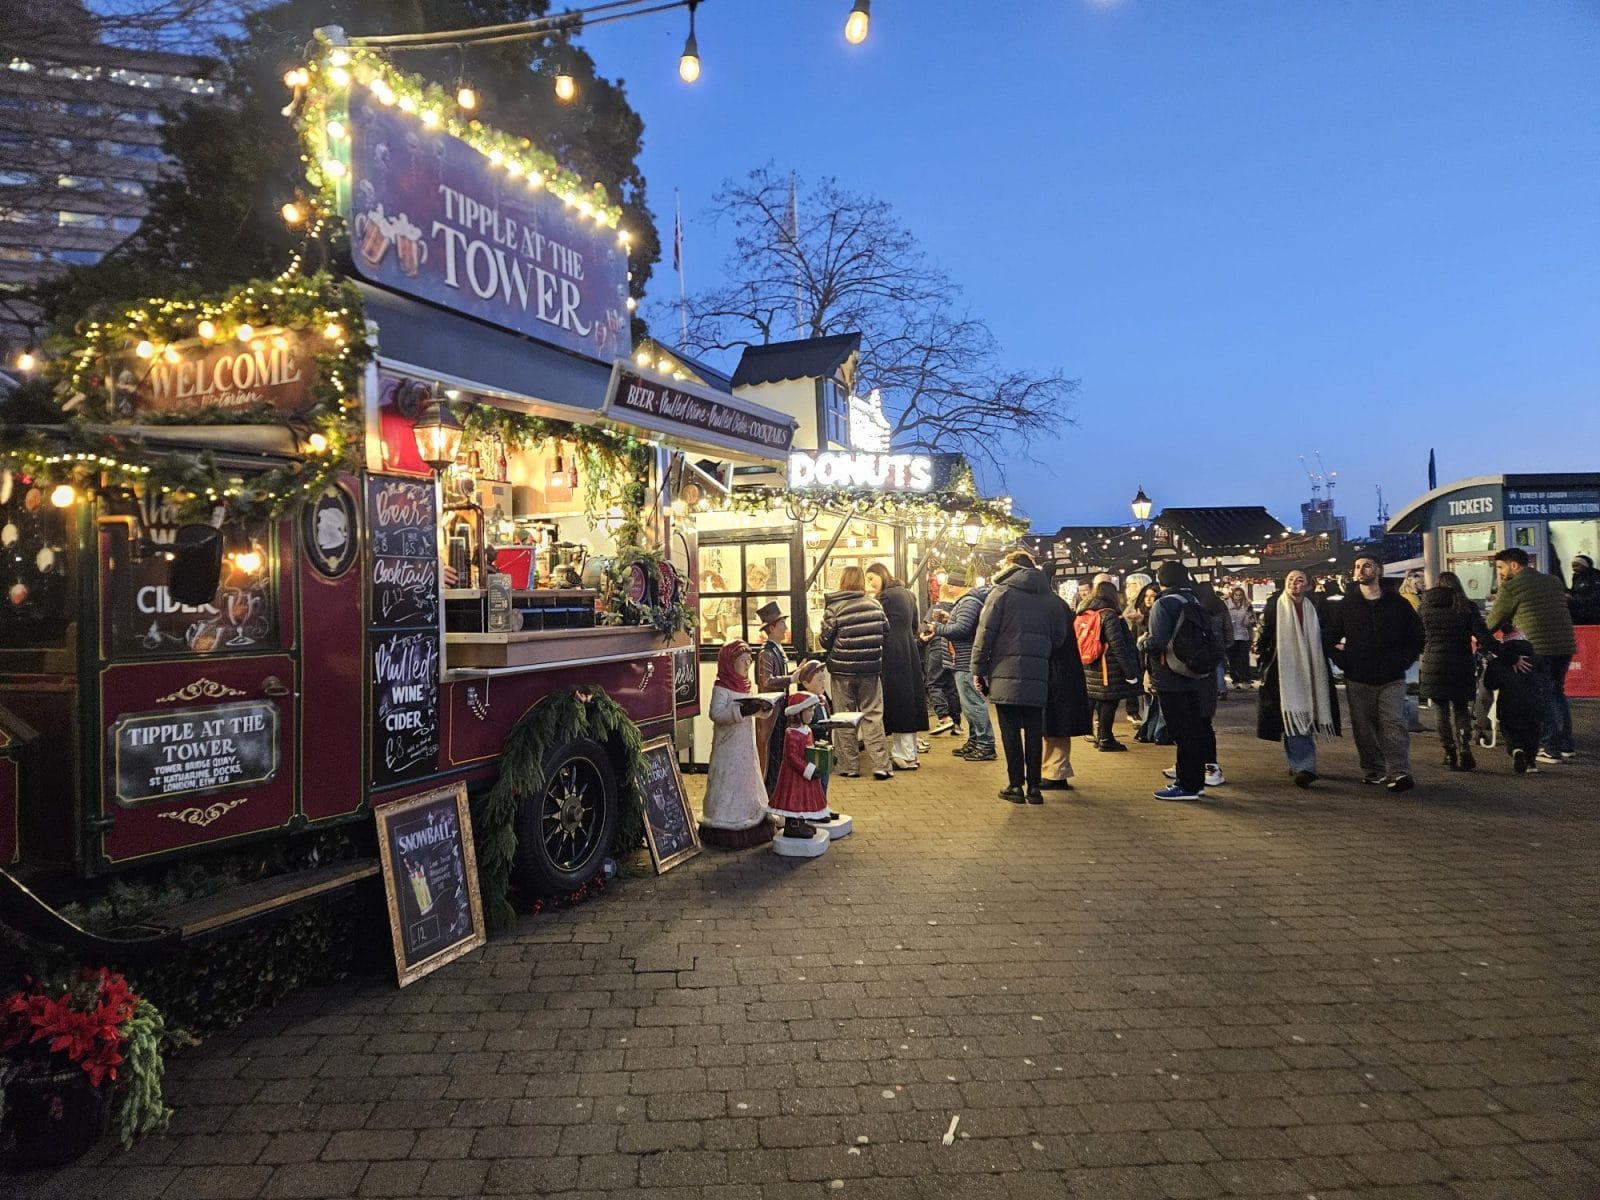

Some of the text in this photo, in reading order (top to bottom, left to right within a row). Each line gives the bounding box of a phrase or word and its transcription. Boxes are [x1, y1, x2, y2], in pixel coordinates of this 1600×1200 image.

[439, 184, 584, 281] TIPPLE AT THE
[432, 221, 592, 337] TOWER
[150, 346, 300, 399] WELCOME
[626, 385, 655, 412] BEER
[789, 453, 932, 492] DONUTS
[376, 491, 429, 526] Beer
[1448, 497, 1493, 516] TICKETS
[1508, 504, 1539, 514] TICKETS
[1549, 503, 1599, 513] INFORMATION
[374, 559, 434, 587] Cocktails
[375, 644, 433, 684] Mulled
[392, 684, 424, 705] WINE
[127, 714, 265, 746] TIPPLE AT THE
[386, 710, 425, 731] CIDER
[163, 738, 236, 763] TOWER
[154, 763, 182, 775] TOWER
[185, 759, 211, 771] BRIDGE
[399, 821, 452, 854] SNOWBALL
